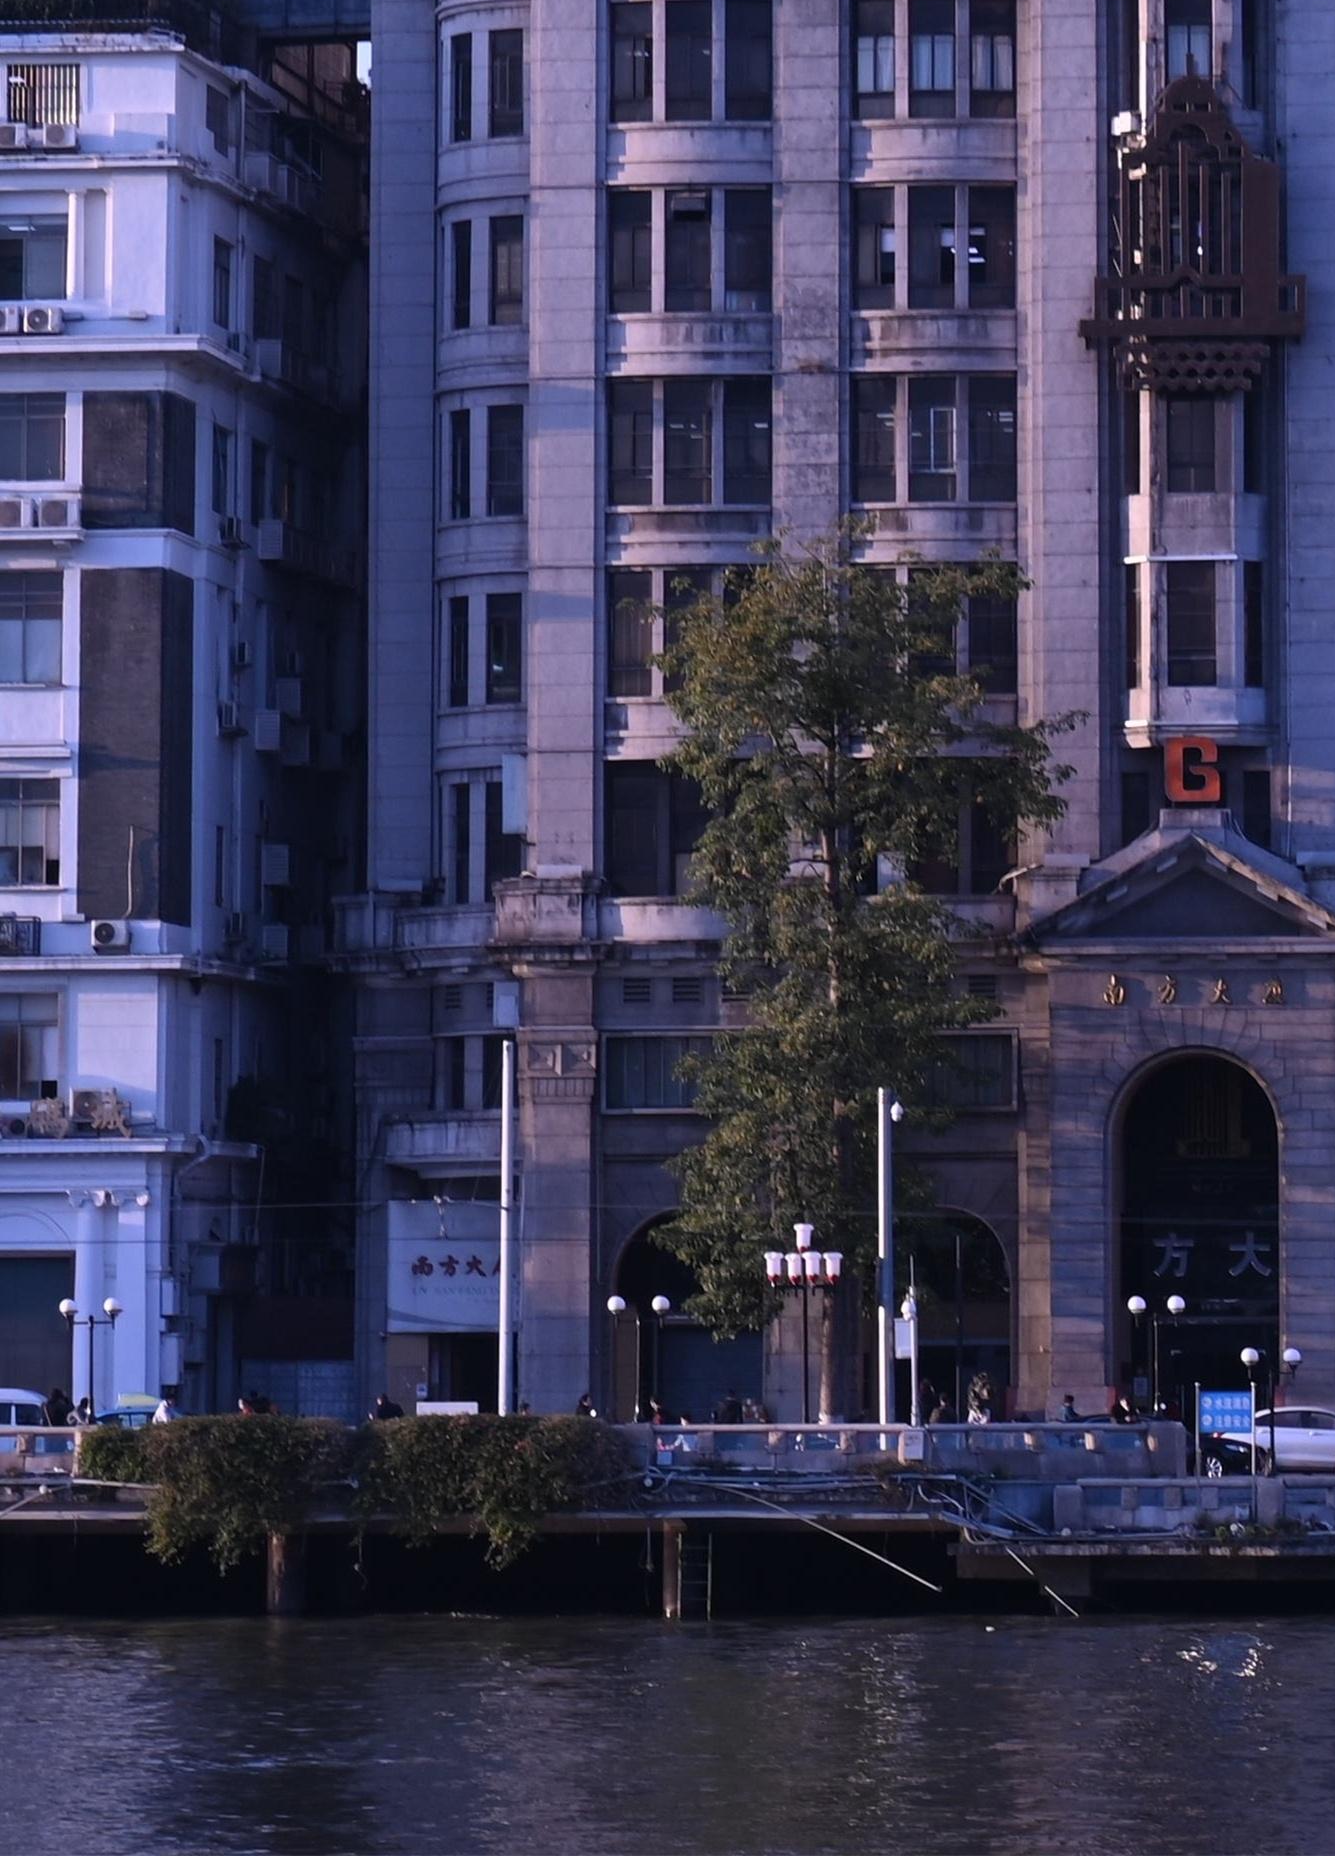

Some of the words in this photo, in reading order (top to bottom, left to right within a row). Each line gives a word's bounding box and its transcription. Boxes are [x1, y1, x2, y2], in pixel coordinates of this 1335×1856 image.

[1164, 737, 1220, 802] G
[411, 1255, 500, 1277] 南方大
